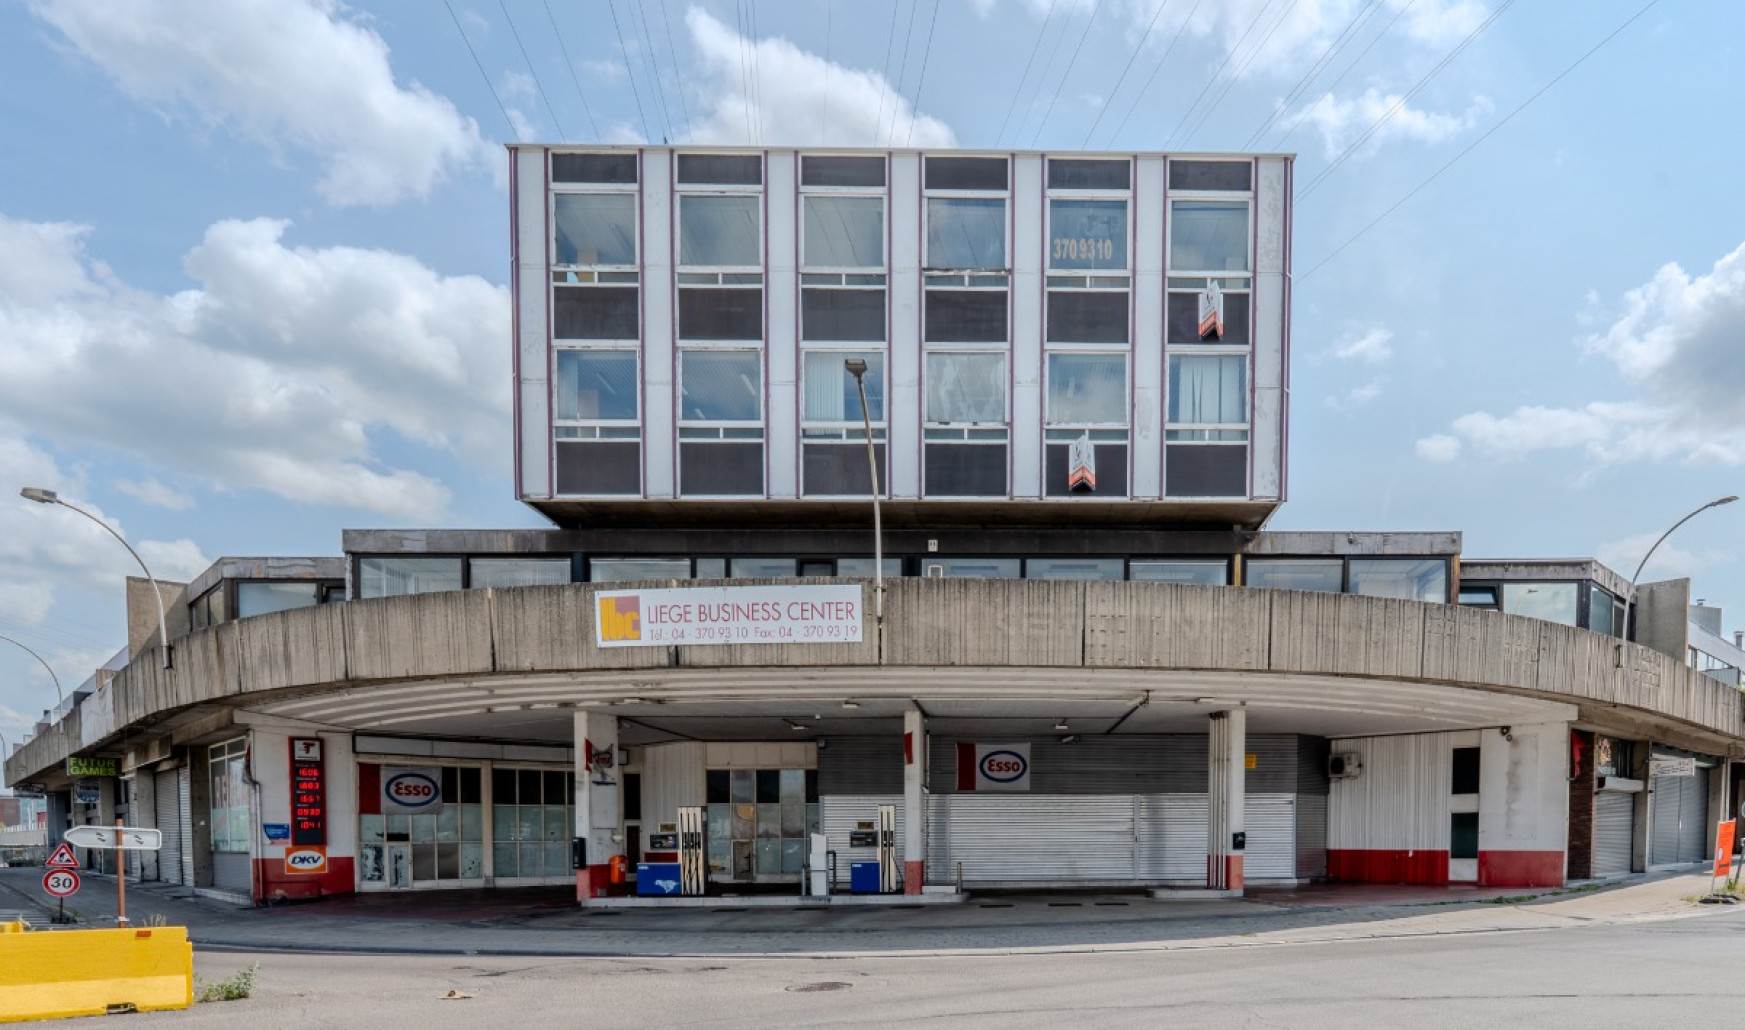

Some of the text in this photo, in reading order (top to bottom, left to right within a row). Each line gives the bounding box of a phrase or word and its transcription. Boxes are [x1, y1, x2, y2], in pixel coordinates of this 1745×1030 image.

[648, 601, 855, 624] LIEGE BUSINESS CENTER
[671, 627, 685, 640] 04
[695, 627, 714, 640] 370
[718, 627, 731, 639] 93
[736, 626, 748, 638] 10
[754, 626, 775, 638] Fax:
[779, 626, 792, 638] 04
[803, 625, 823, 638] 370
[827, 625, 840, 637] 93
[845, 625, 858, 637] 19
[69, 757, 116, 766] FUTUR
[987, 758, 1020, 772] Esso
[69, 766, 116, 776] GAMES
[394, 781, 432, 797] Esso
[291, 855, 321, 865] DKV
[50, 876, 72, 888] 30
